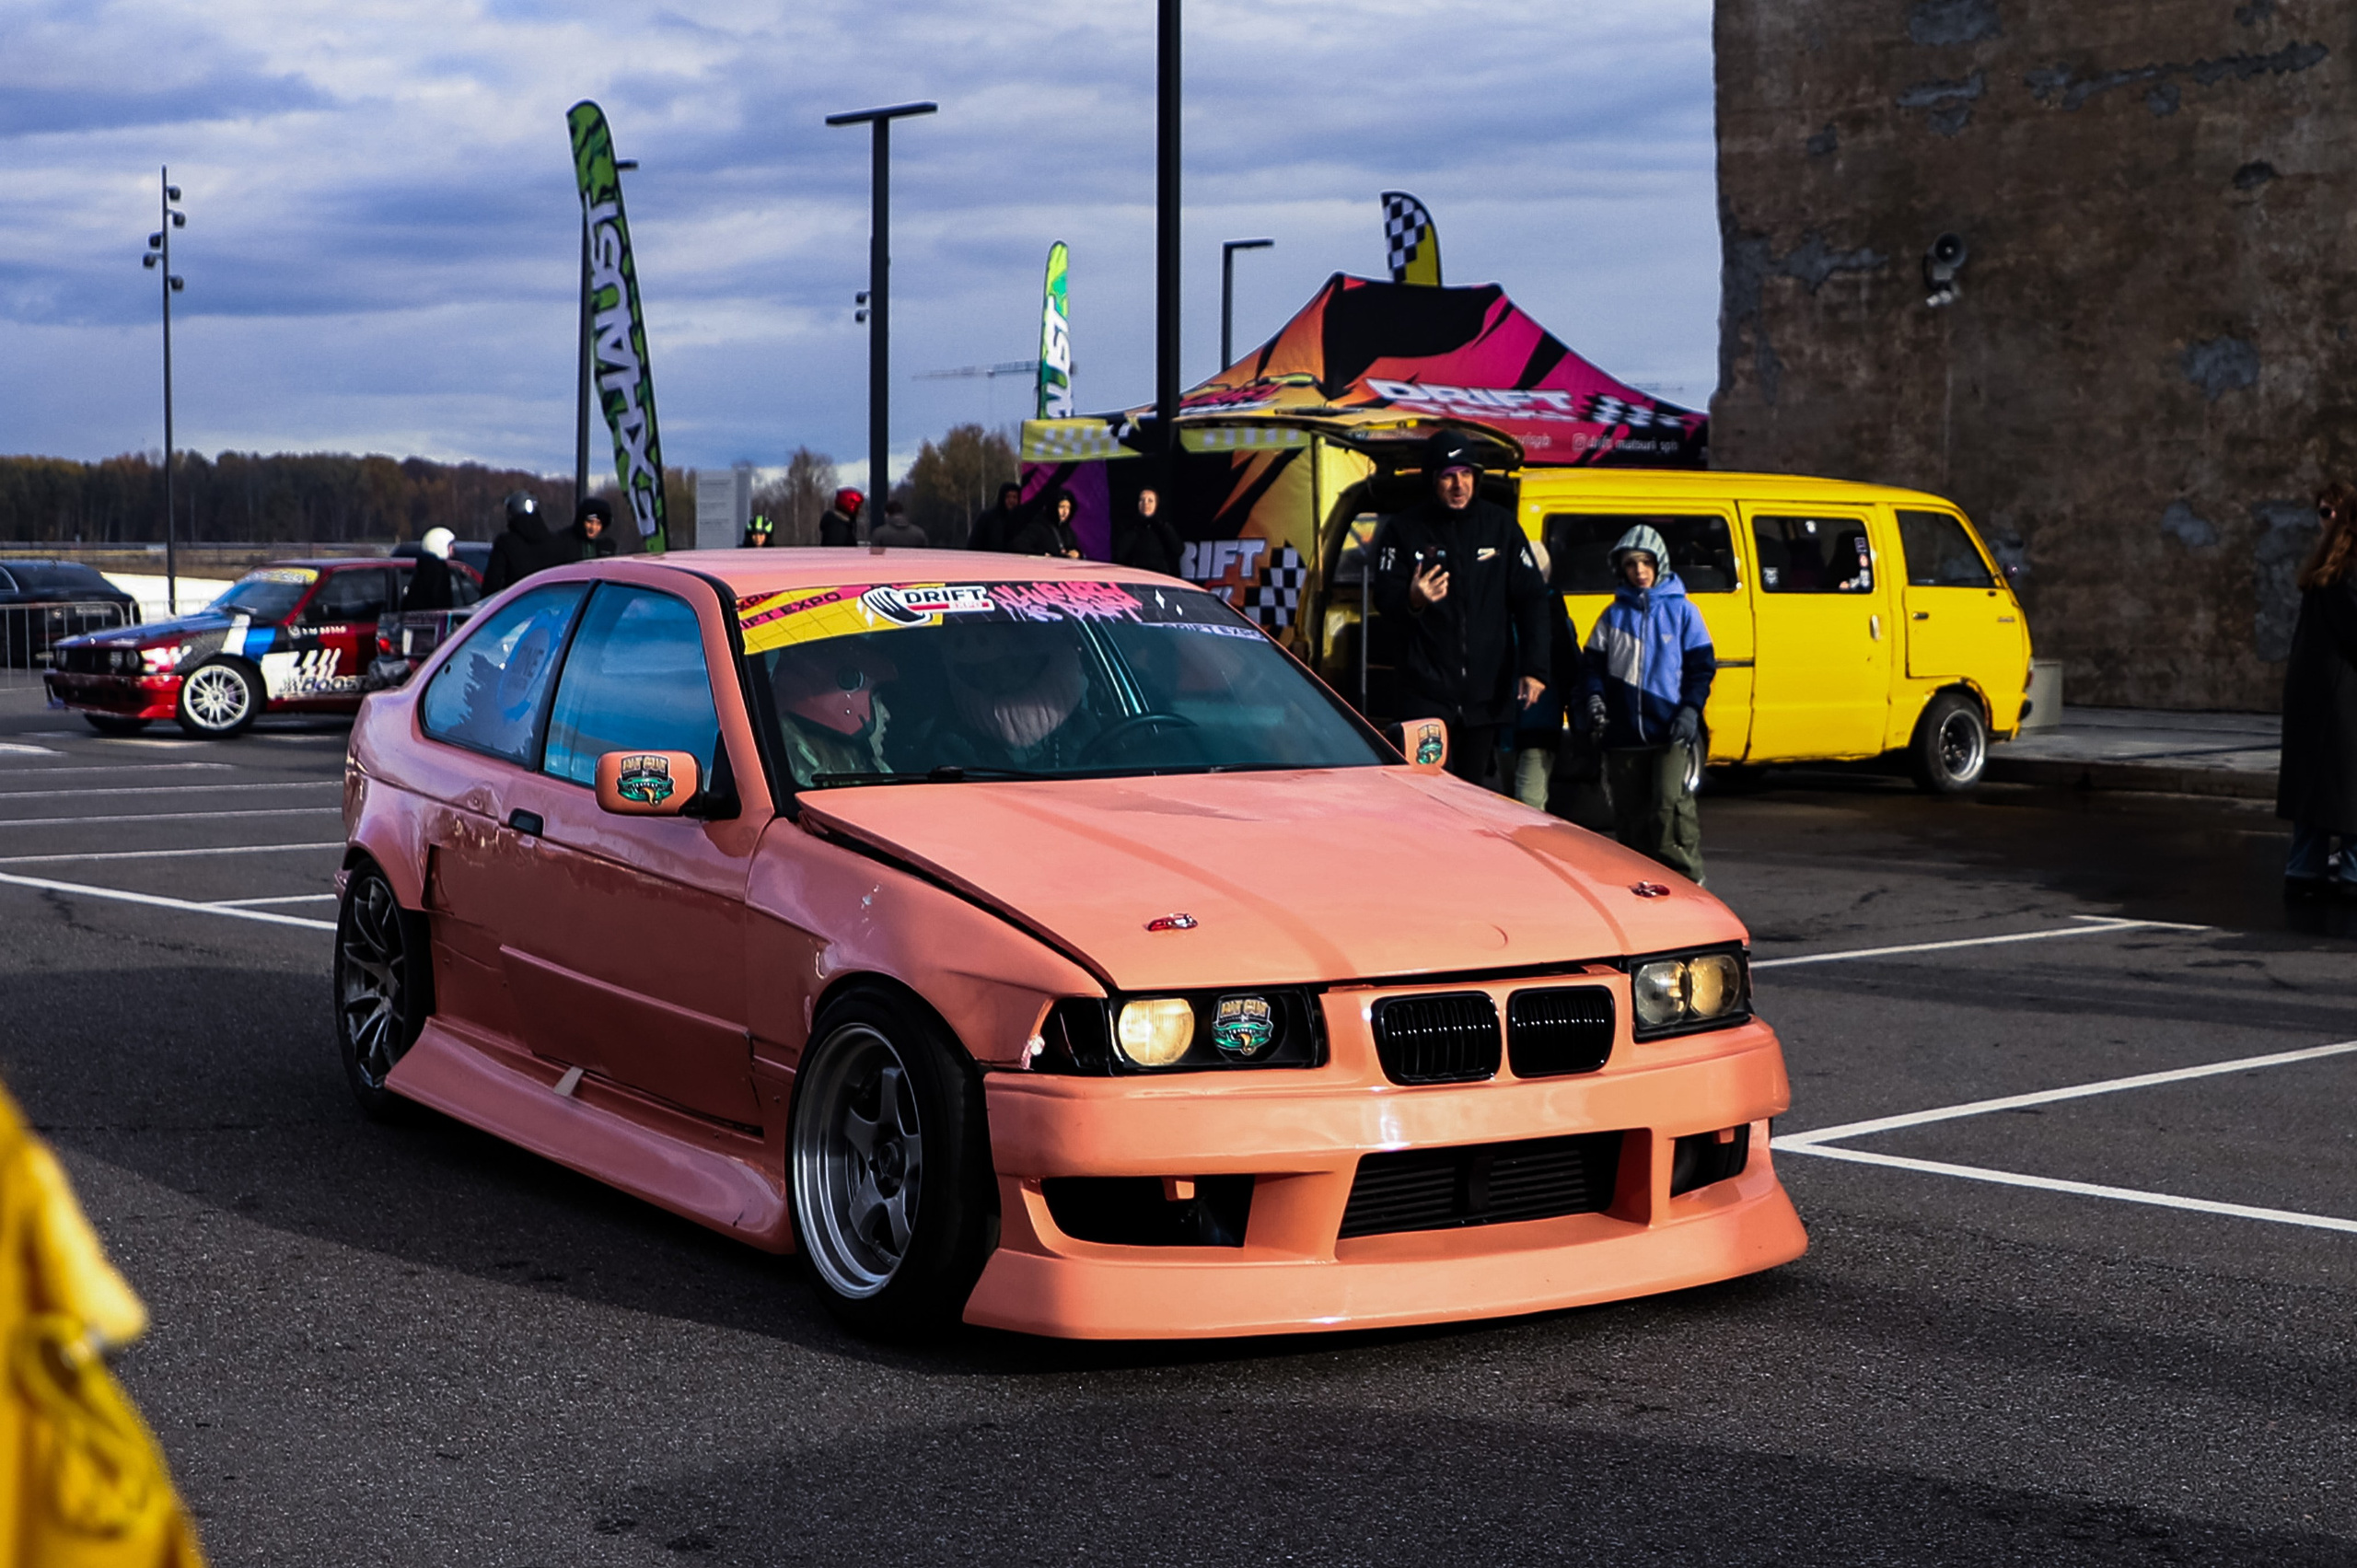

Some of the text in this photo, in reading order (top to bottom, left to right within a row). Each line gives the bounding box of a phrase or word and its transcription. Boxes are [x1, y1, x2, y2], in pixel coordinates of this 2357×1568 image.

[586, 192, 657, 538] EXHAUST
[1046, 294, 1073, 418] AUST
[1366, 377, 1573, 410] DRIFT
[1177, 539, 1265, 579] RIFT
[779, 591, 842, 615] EXPO
[904, 587, 983, 603] DRIFT
